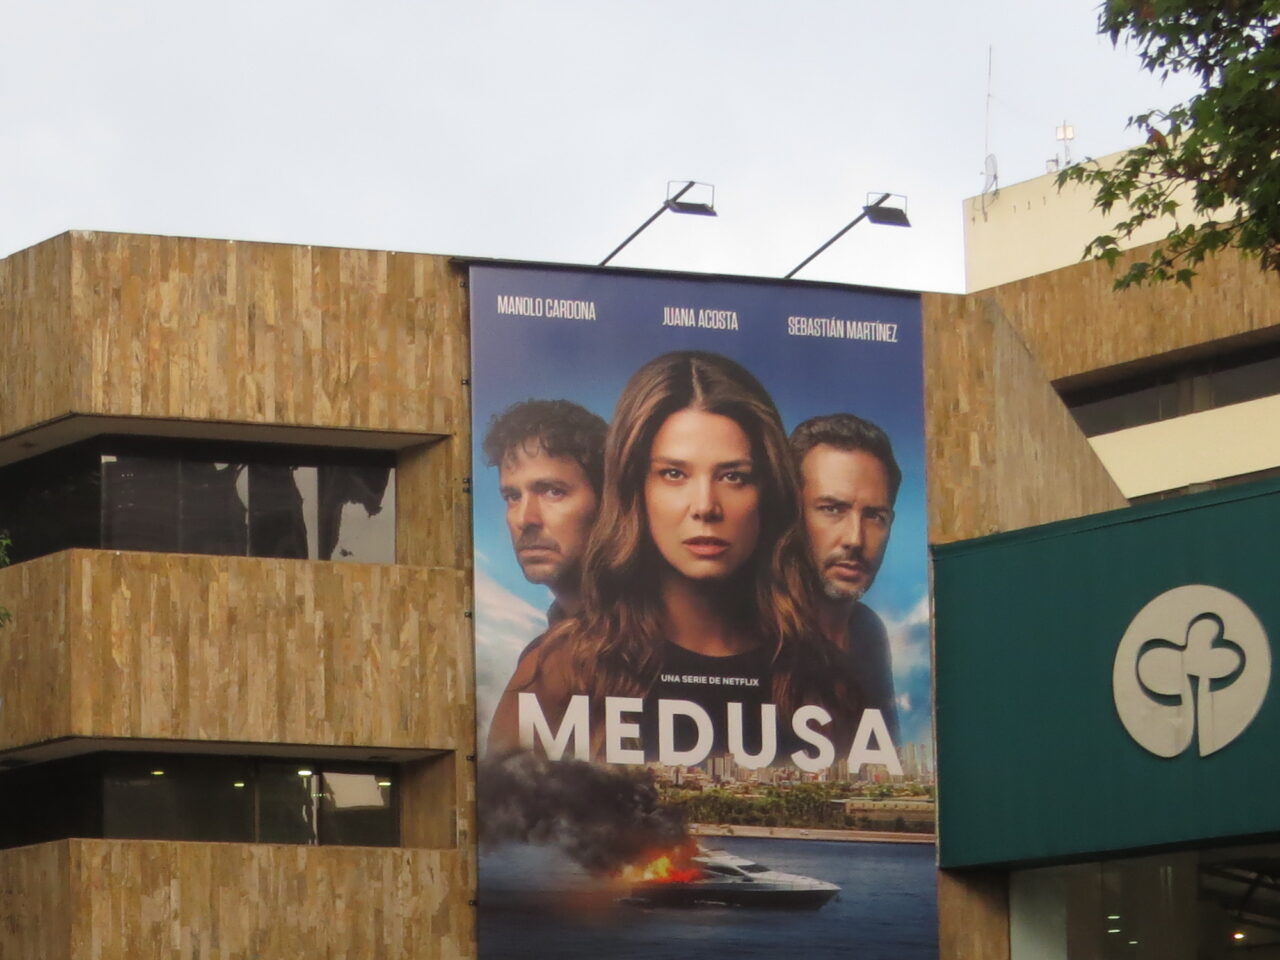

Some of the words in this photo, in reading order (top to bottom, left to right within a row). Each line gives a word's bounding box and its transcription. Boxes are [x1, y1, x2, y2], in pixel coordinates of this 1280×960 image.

[497, 295, 543, 318] MANOLO
[545, 298, 596, 321] CARDONA
[662, 307, 696, 328] JUANA
[697, 309, 738, 331] ACOSTA
[788, 315, 844, 339] SEBASTIÁN
[846, 318, 898, 343] MARTÍNEZ
[661, 674, 680, 684] UNA
[681, 675, 707, 685] SERIE
[709, 676, 721, 686] DE
[722, 677, 759, 687] NETFLIX
[517, 692, 903, 776] MEDUSA
